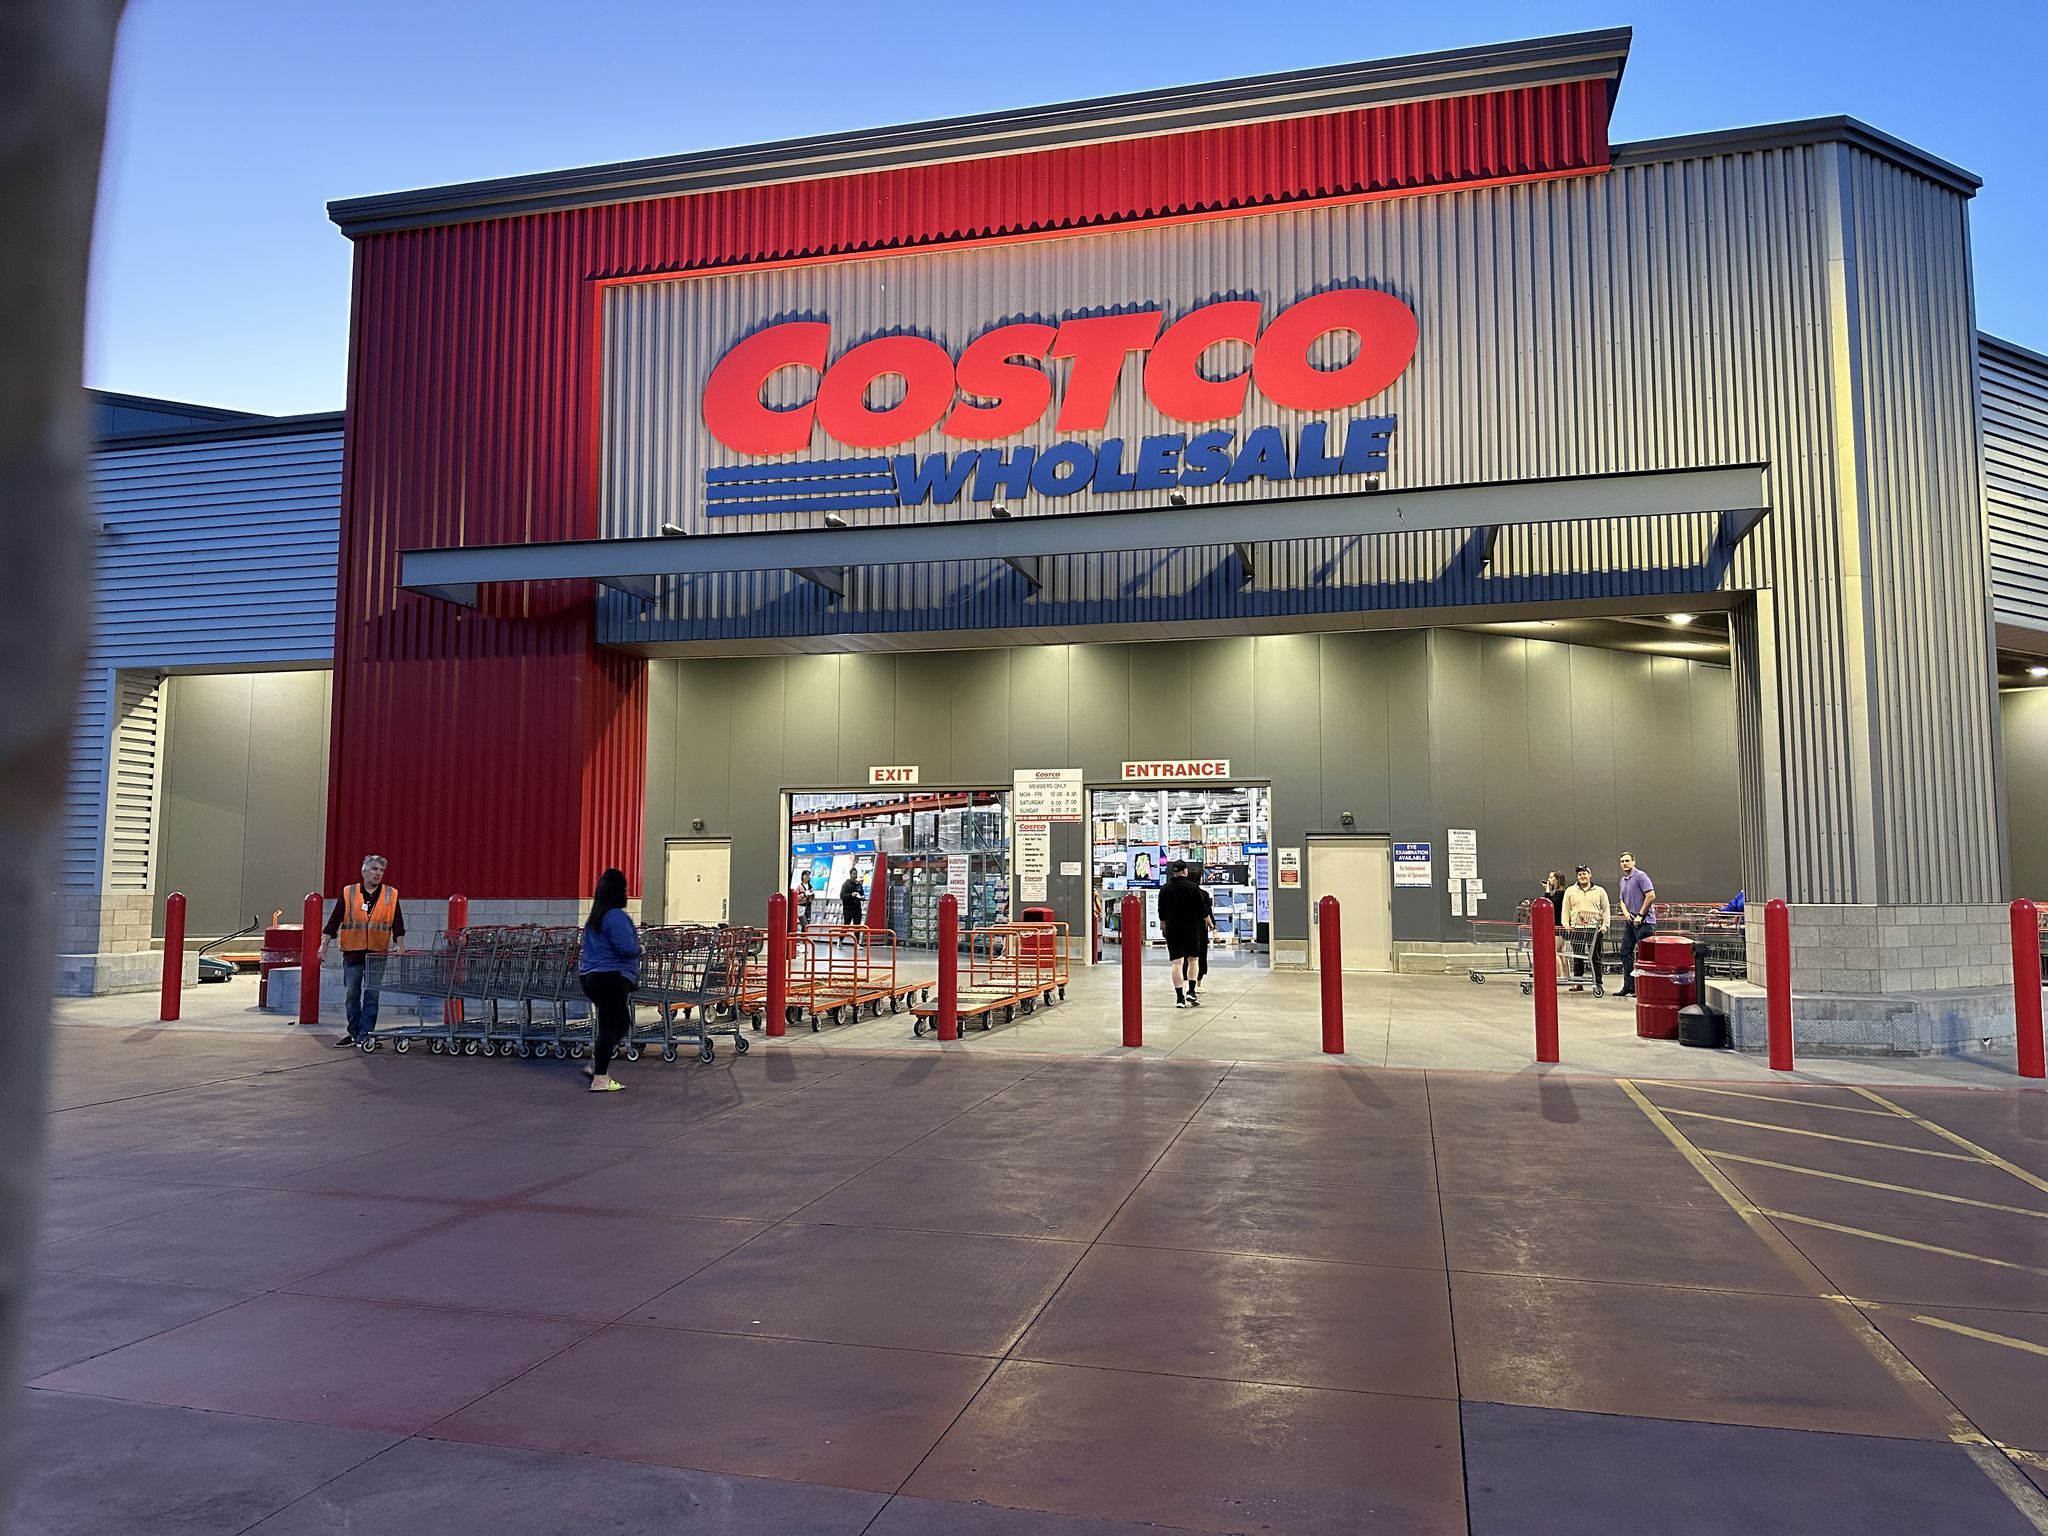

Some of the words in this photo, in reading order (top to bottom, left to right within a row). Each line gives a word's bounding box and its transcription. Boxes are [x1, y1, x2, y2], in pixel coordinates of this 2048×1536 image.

[702, 287, 1419, 456] COSTCO
[892, 416, 1397, 506] WHOLESALE
[874, 769, 914, 782] EXIT
[1125, 762, 1227, 778] ENTRANCE
